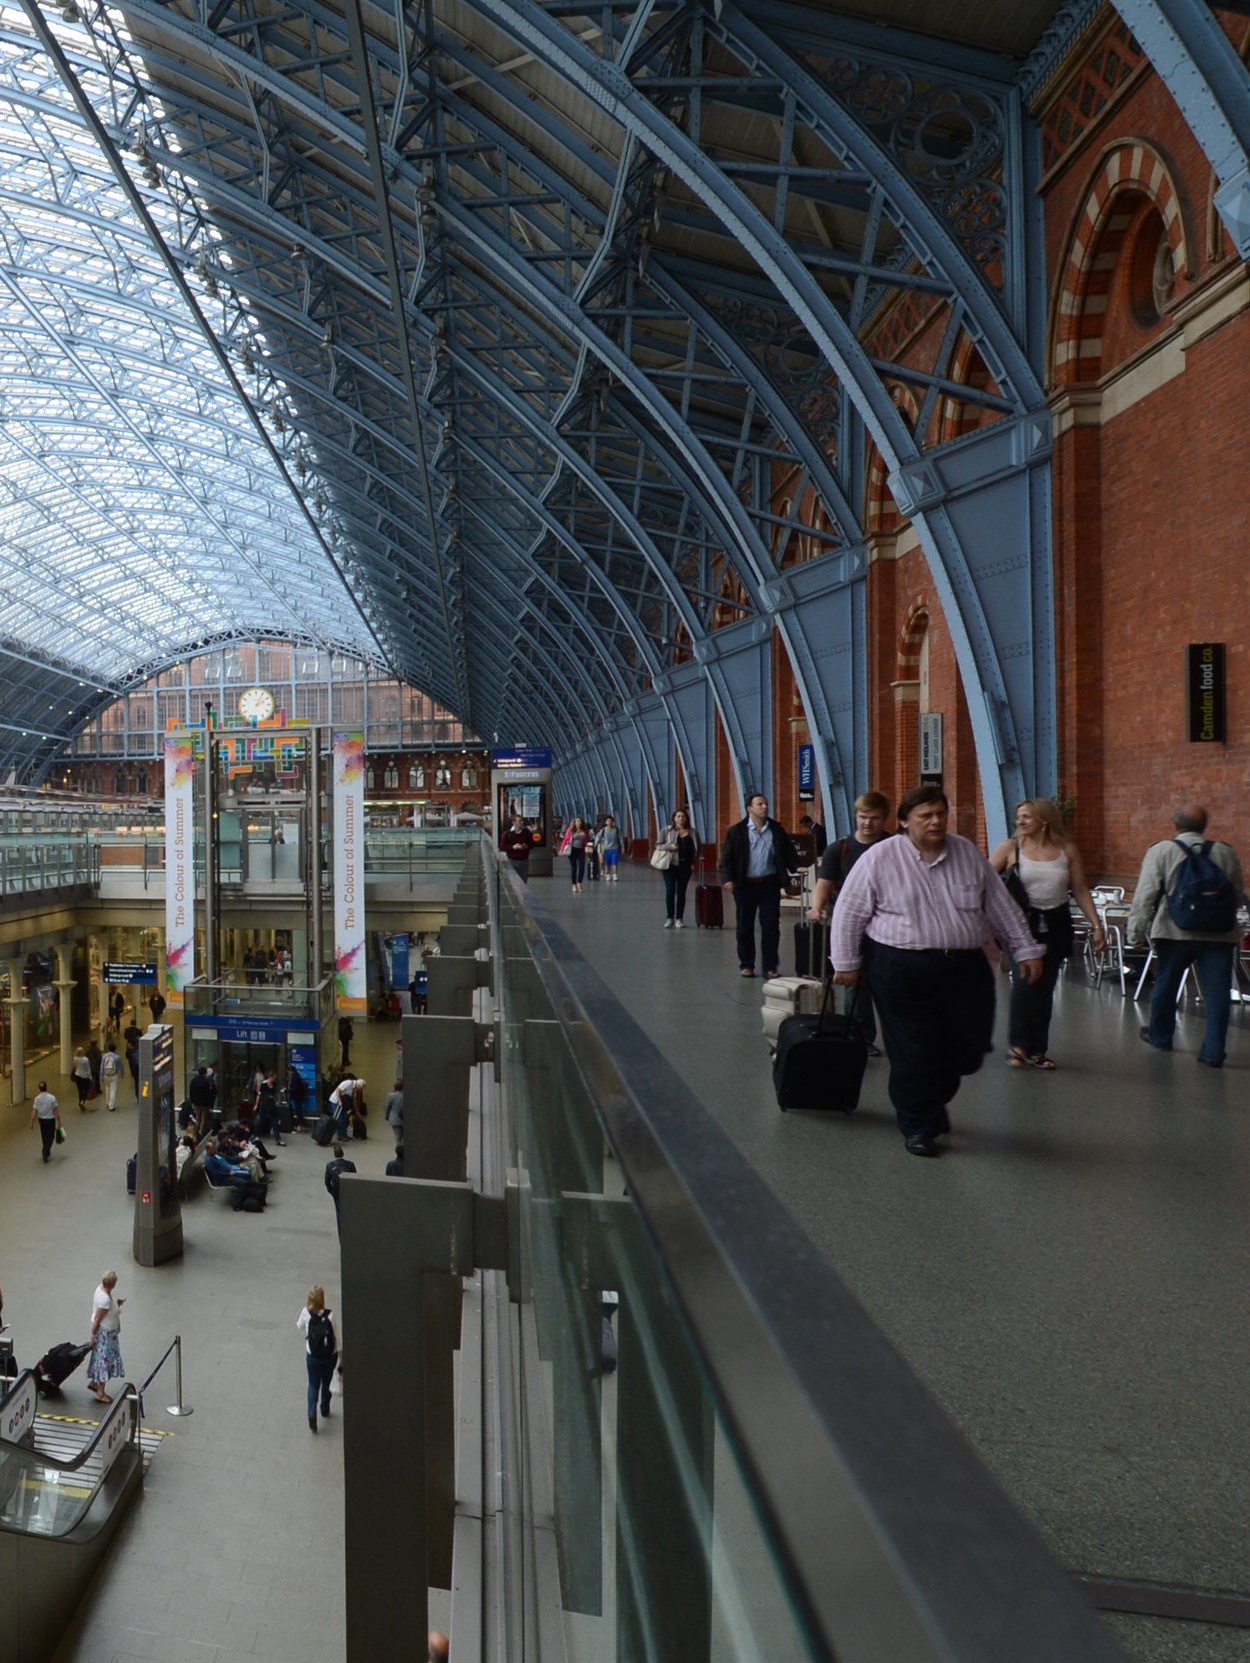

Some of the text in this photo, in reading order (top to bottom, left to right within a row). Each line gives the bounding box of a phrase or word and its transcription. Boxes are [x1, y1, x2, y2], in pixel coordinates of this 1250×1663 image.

[1200, 646, 1214, 740] Camden food co.
[802, 749, 810, 784] WHSmith
[175, 798, 184, 927] The Colour of Summer
[344, 795, 354, 930] The Colour of Summer
[236, 1030, 248, 1038] Lift
